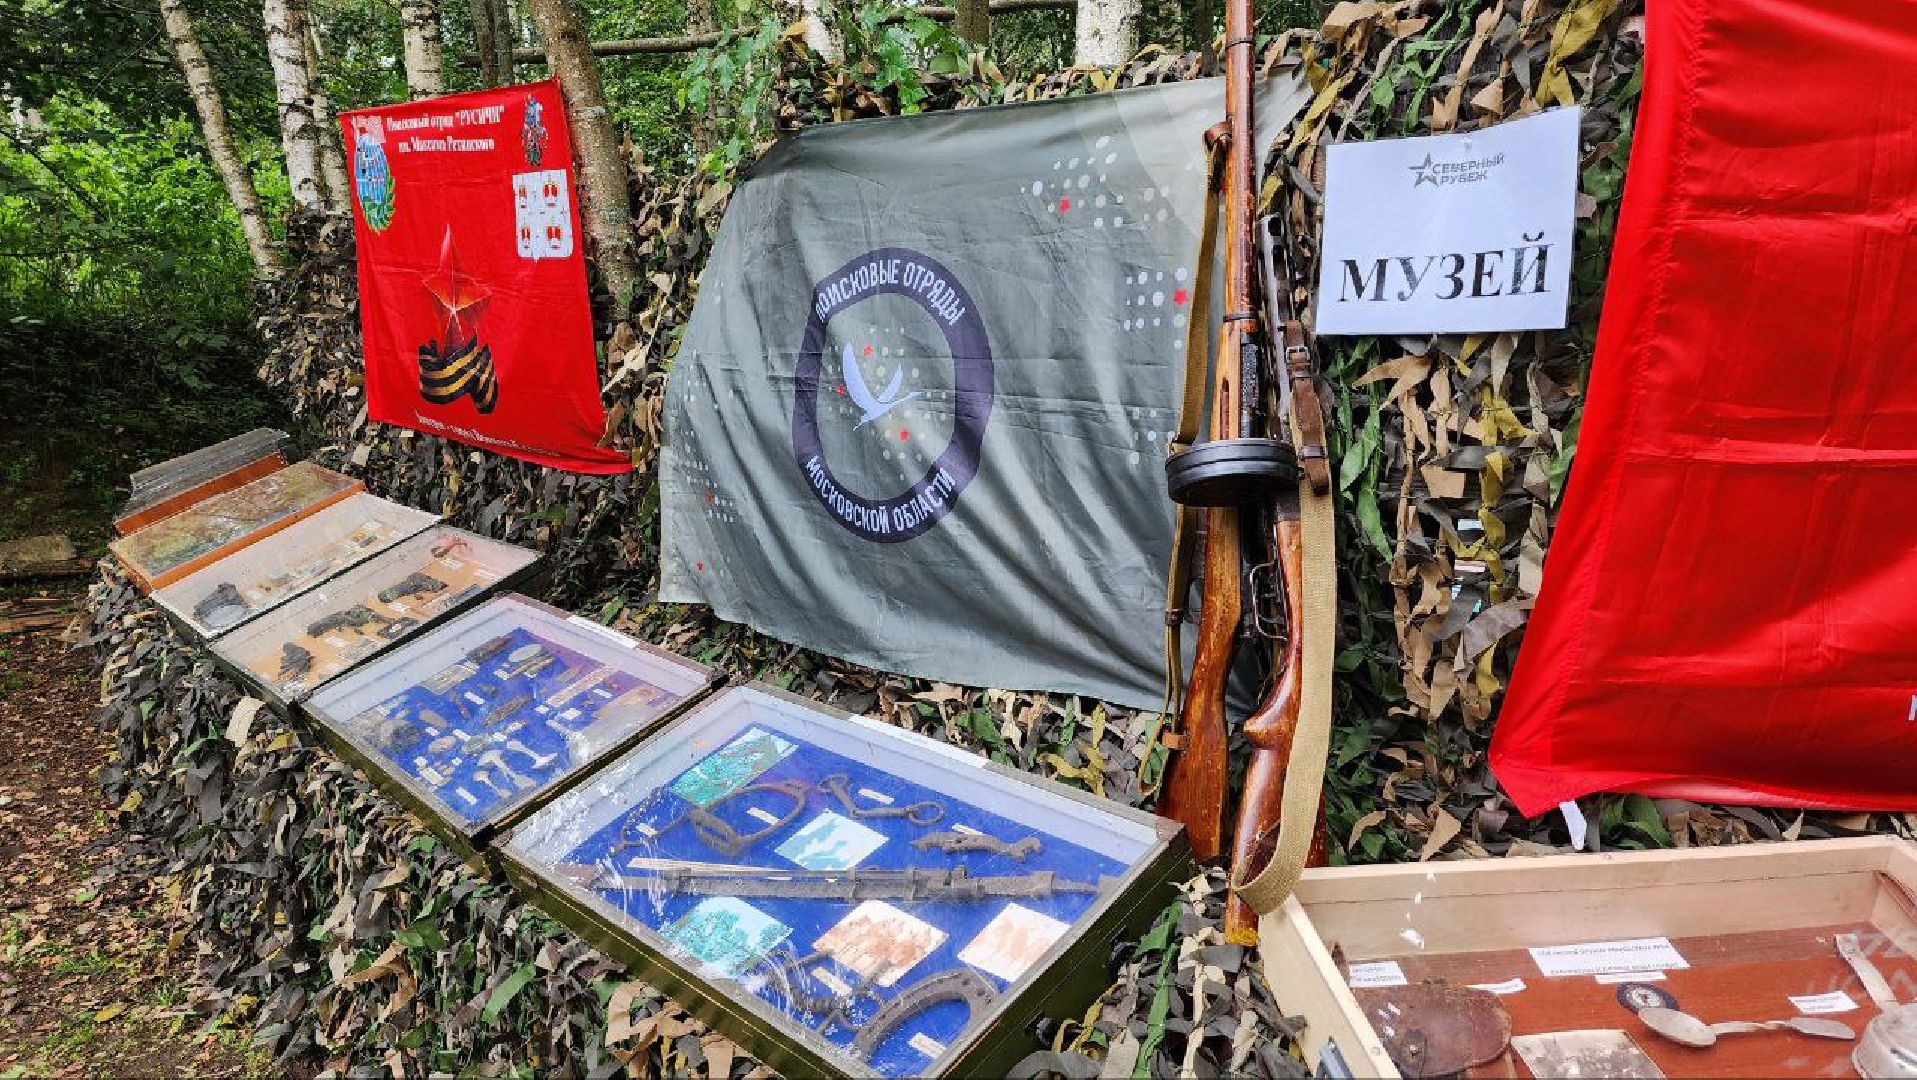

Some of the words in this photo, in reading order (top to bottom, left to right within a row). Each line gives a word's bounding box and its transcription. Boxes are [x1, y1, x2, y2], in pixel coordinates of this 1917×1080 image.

[1432, 152, 1504, 174] СЕВЕРНЫЙ
[1441, 169, 1488, 185] РУБЕЖ
[815, 258, 901, 324] ПОИСКОВЫЕ
[902, 261, 966, 326] ОТРЯДЫ
[1337, 230, 1556, 303] МУЗЕЙ
[805, 454, 890, 534] МОСКОВСКОЙ
[892, 467, 956, 532] ОБЛАСТИ
